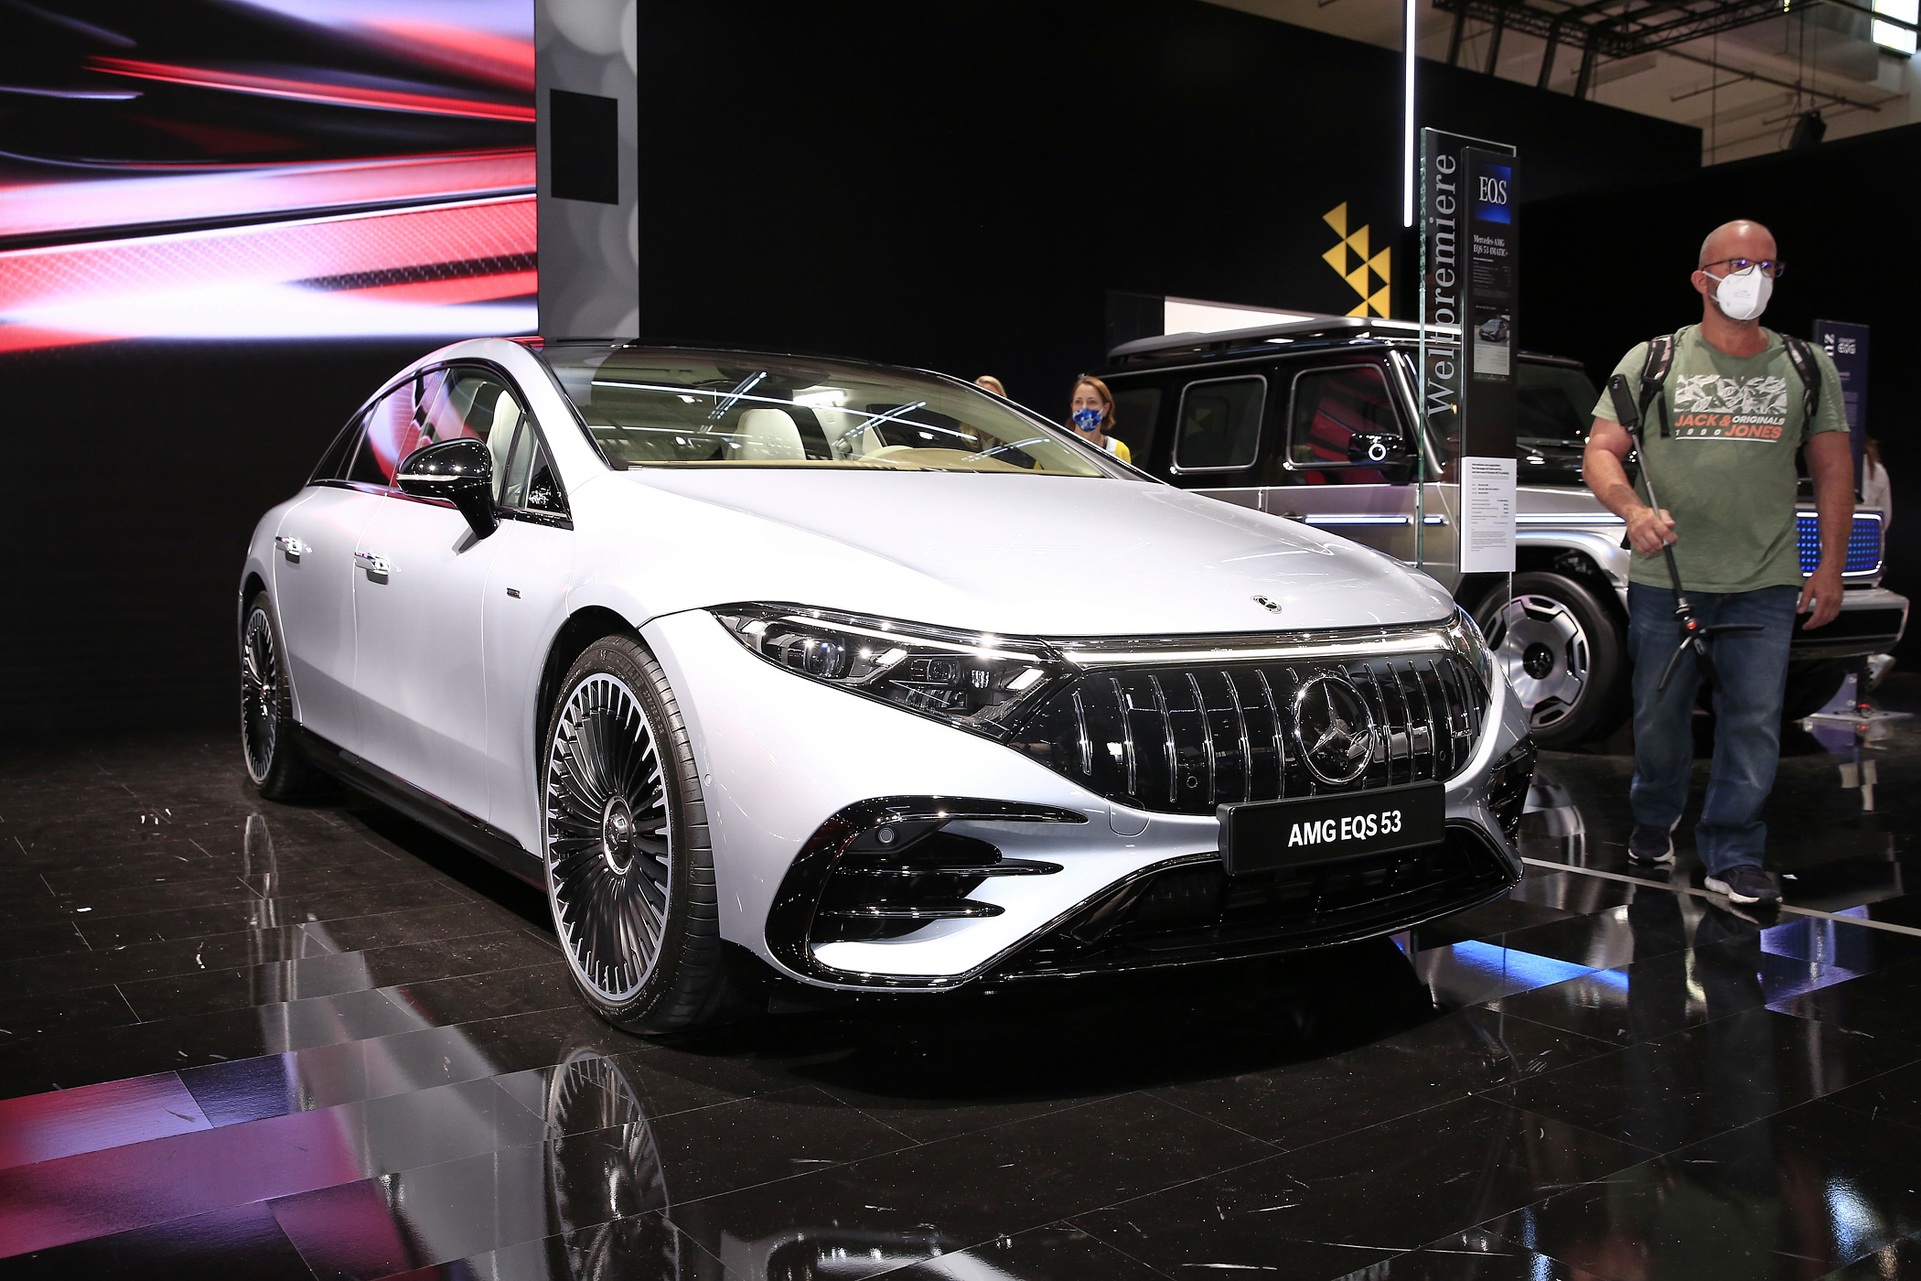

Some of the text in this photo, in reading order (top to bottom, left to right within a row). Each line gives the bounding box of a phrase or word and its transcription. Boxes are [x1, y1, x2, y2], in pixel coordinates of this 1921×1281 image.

[1478, 176, 1508, 205] EQS
[1427, 154, 1456, 417] Weltpremiere
[1675, 414, 1732, 427] JACK &
[1732, 415, 1785, 425] ORIGINALS
[1675, 428, 1721, 436] 1990
[1725, 425, 1783, 439] JONES
[1287, 809, 1402, 848] AMG EQS 53
